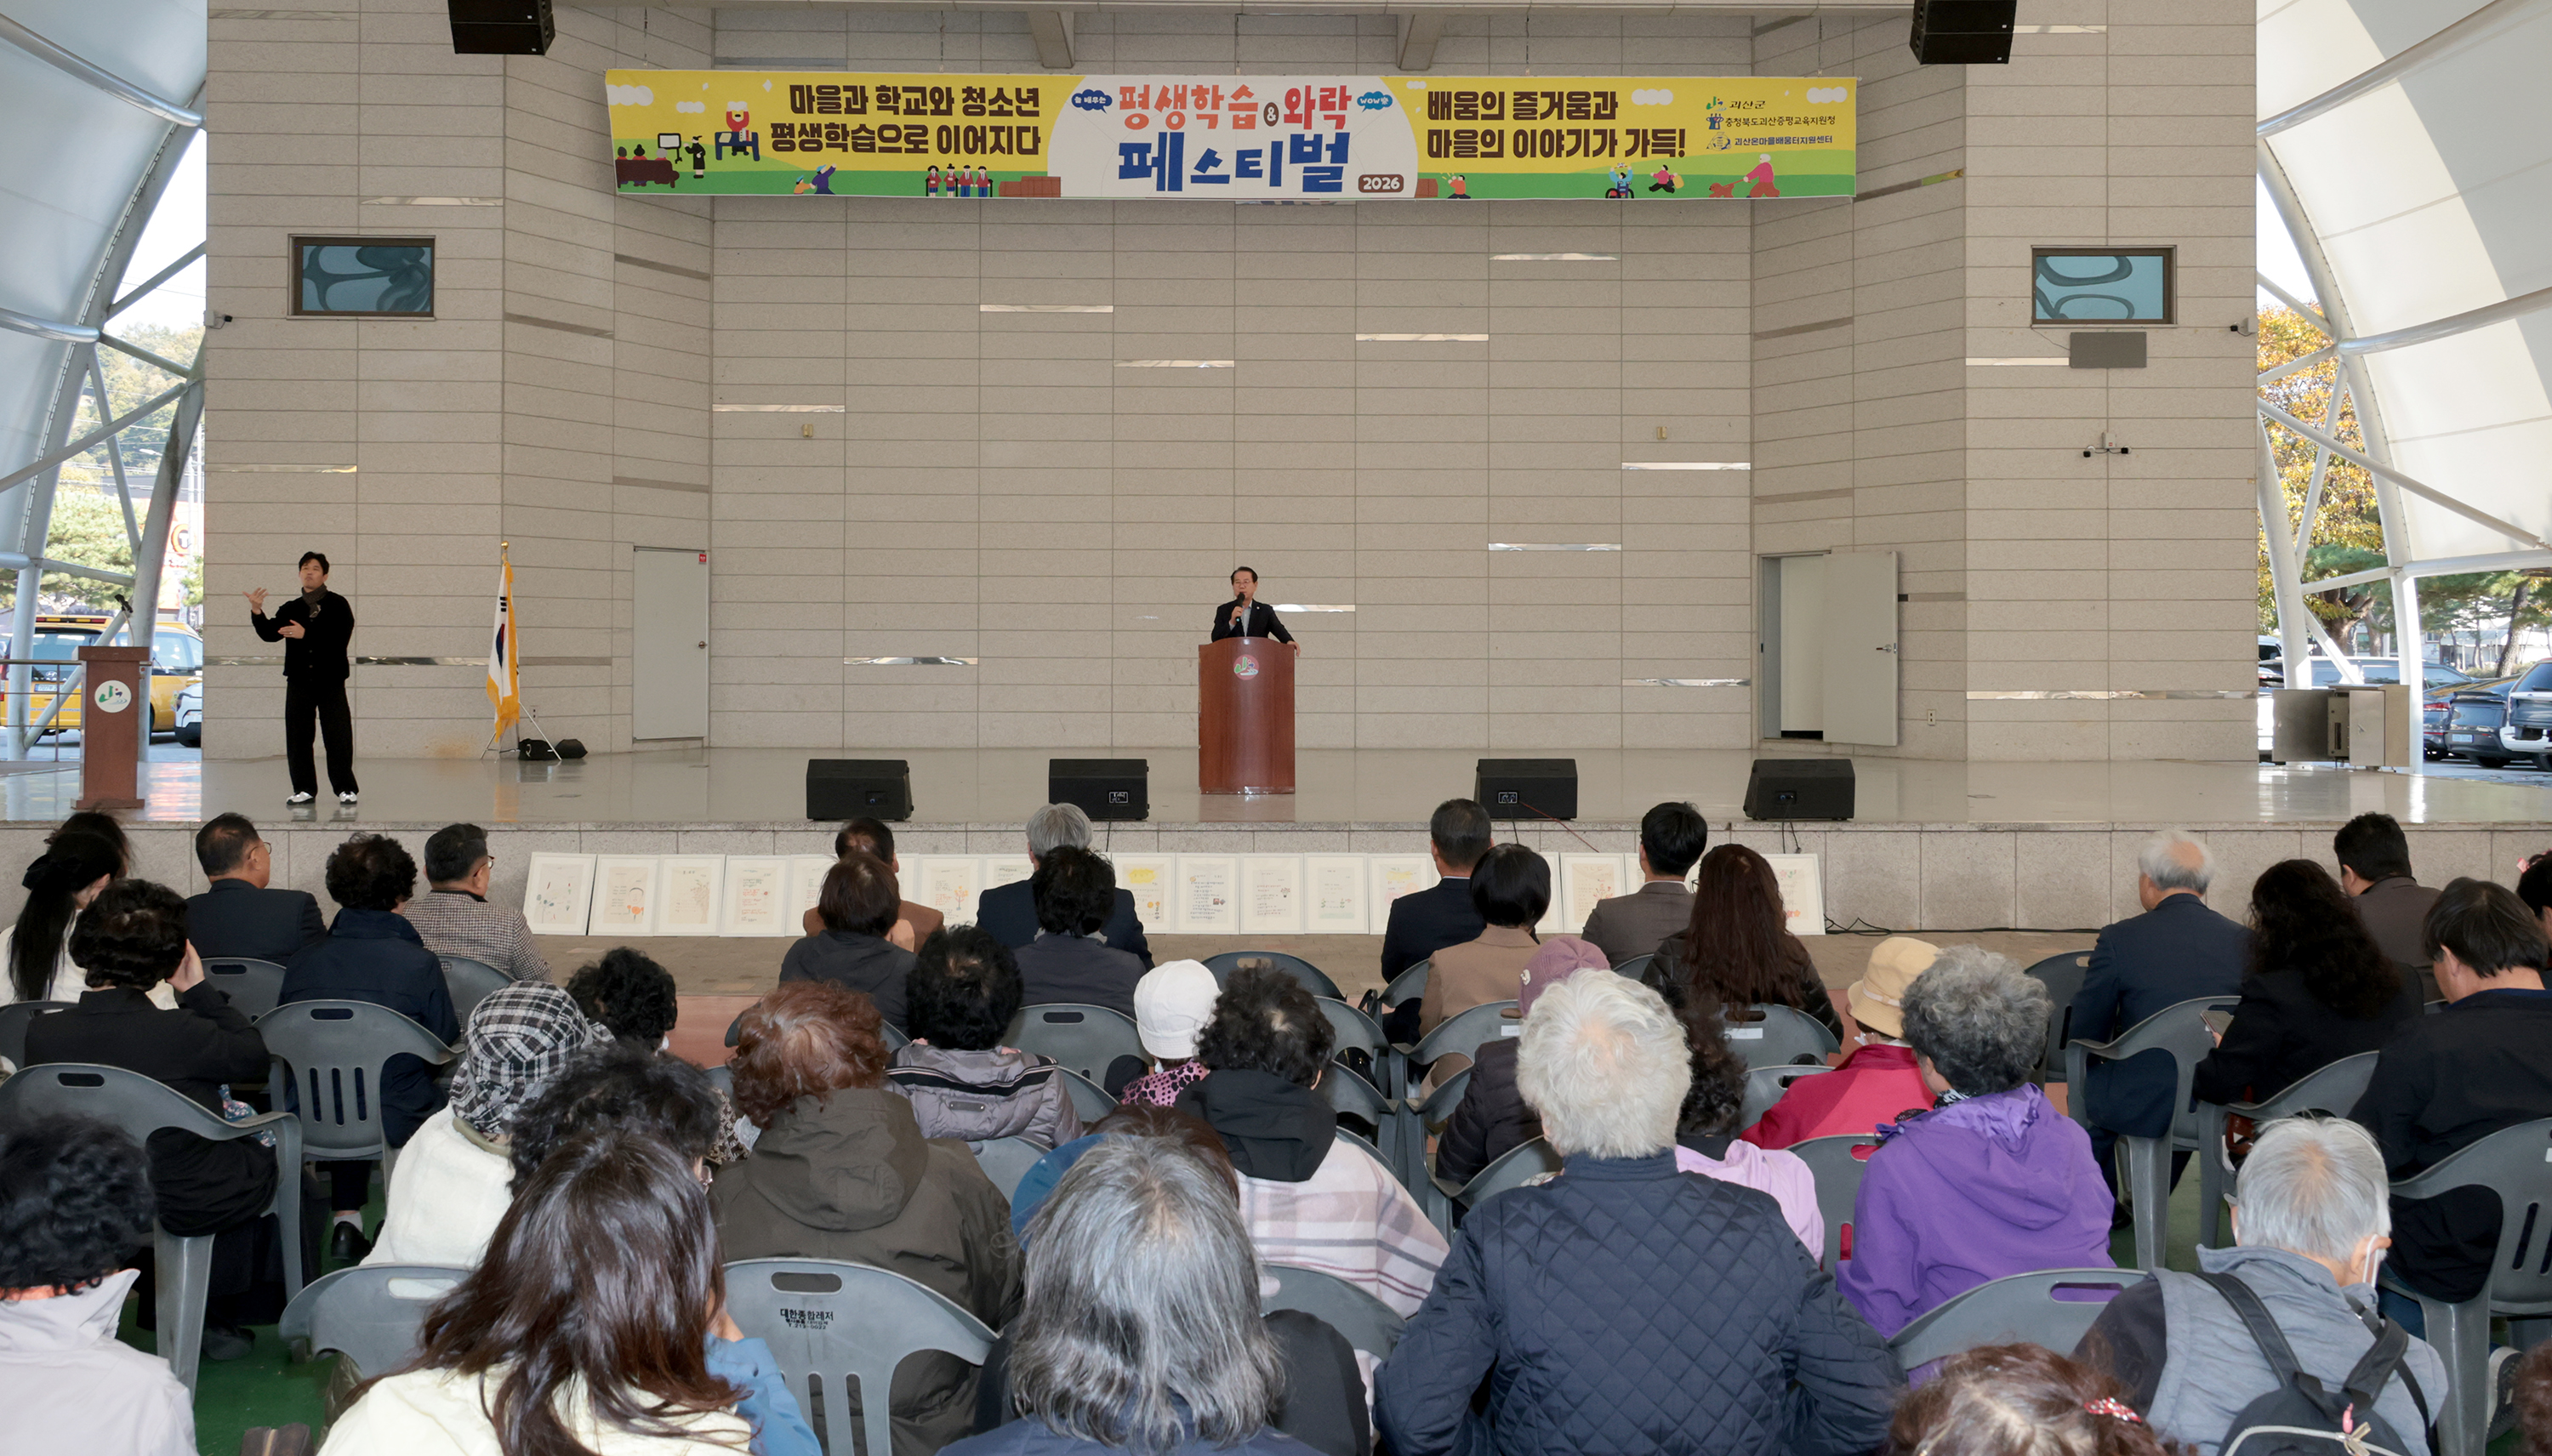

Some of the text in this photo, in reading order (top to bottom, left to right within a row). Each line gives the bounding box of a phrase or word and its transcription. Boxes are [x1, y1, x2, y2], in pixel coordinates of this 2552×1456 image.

[789, 85, 1040, 117] 마을과 학교와 청소년
[1119, 84, 1259, 130] 평생학습
[1284, 85, 1353, 130] 와락
[1427, 91, 1619, 121] 배움의 즐거움과
[1729, 100, 1766, 110] 괴산군
[1725, 115, 1836, 128] 충청북도괴산증평교육지원청
[771, 122, 1041, 156] 평생학습으로 이어지다
[1427, 128, 1686, 158] 마을의 이야기가 가득!
[1119, 132, 1350, 192] 페스티벌
[1363, 176, 1400, 191] 2026
[780, 1308, 834, 1321] 대한종합레저
